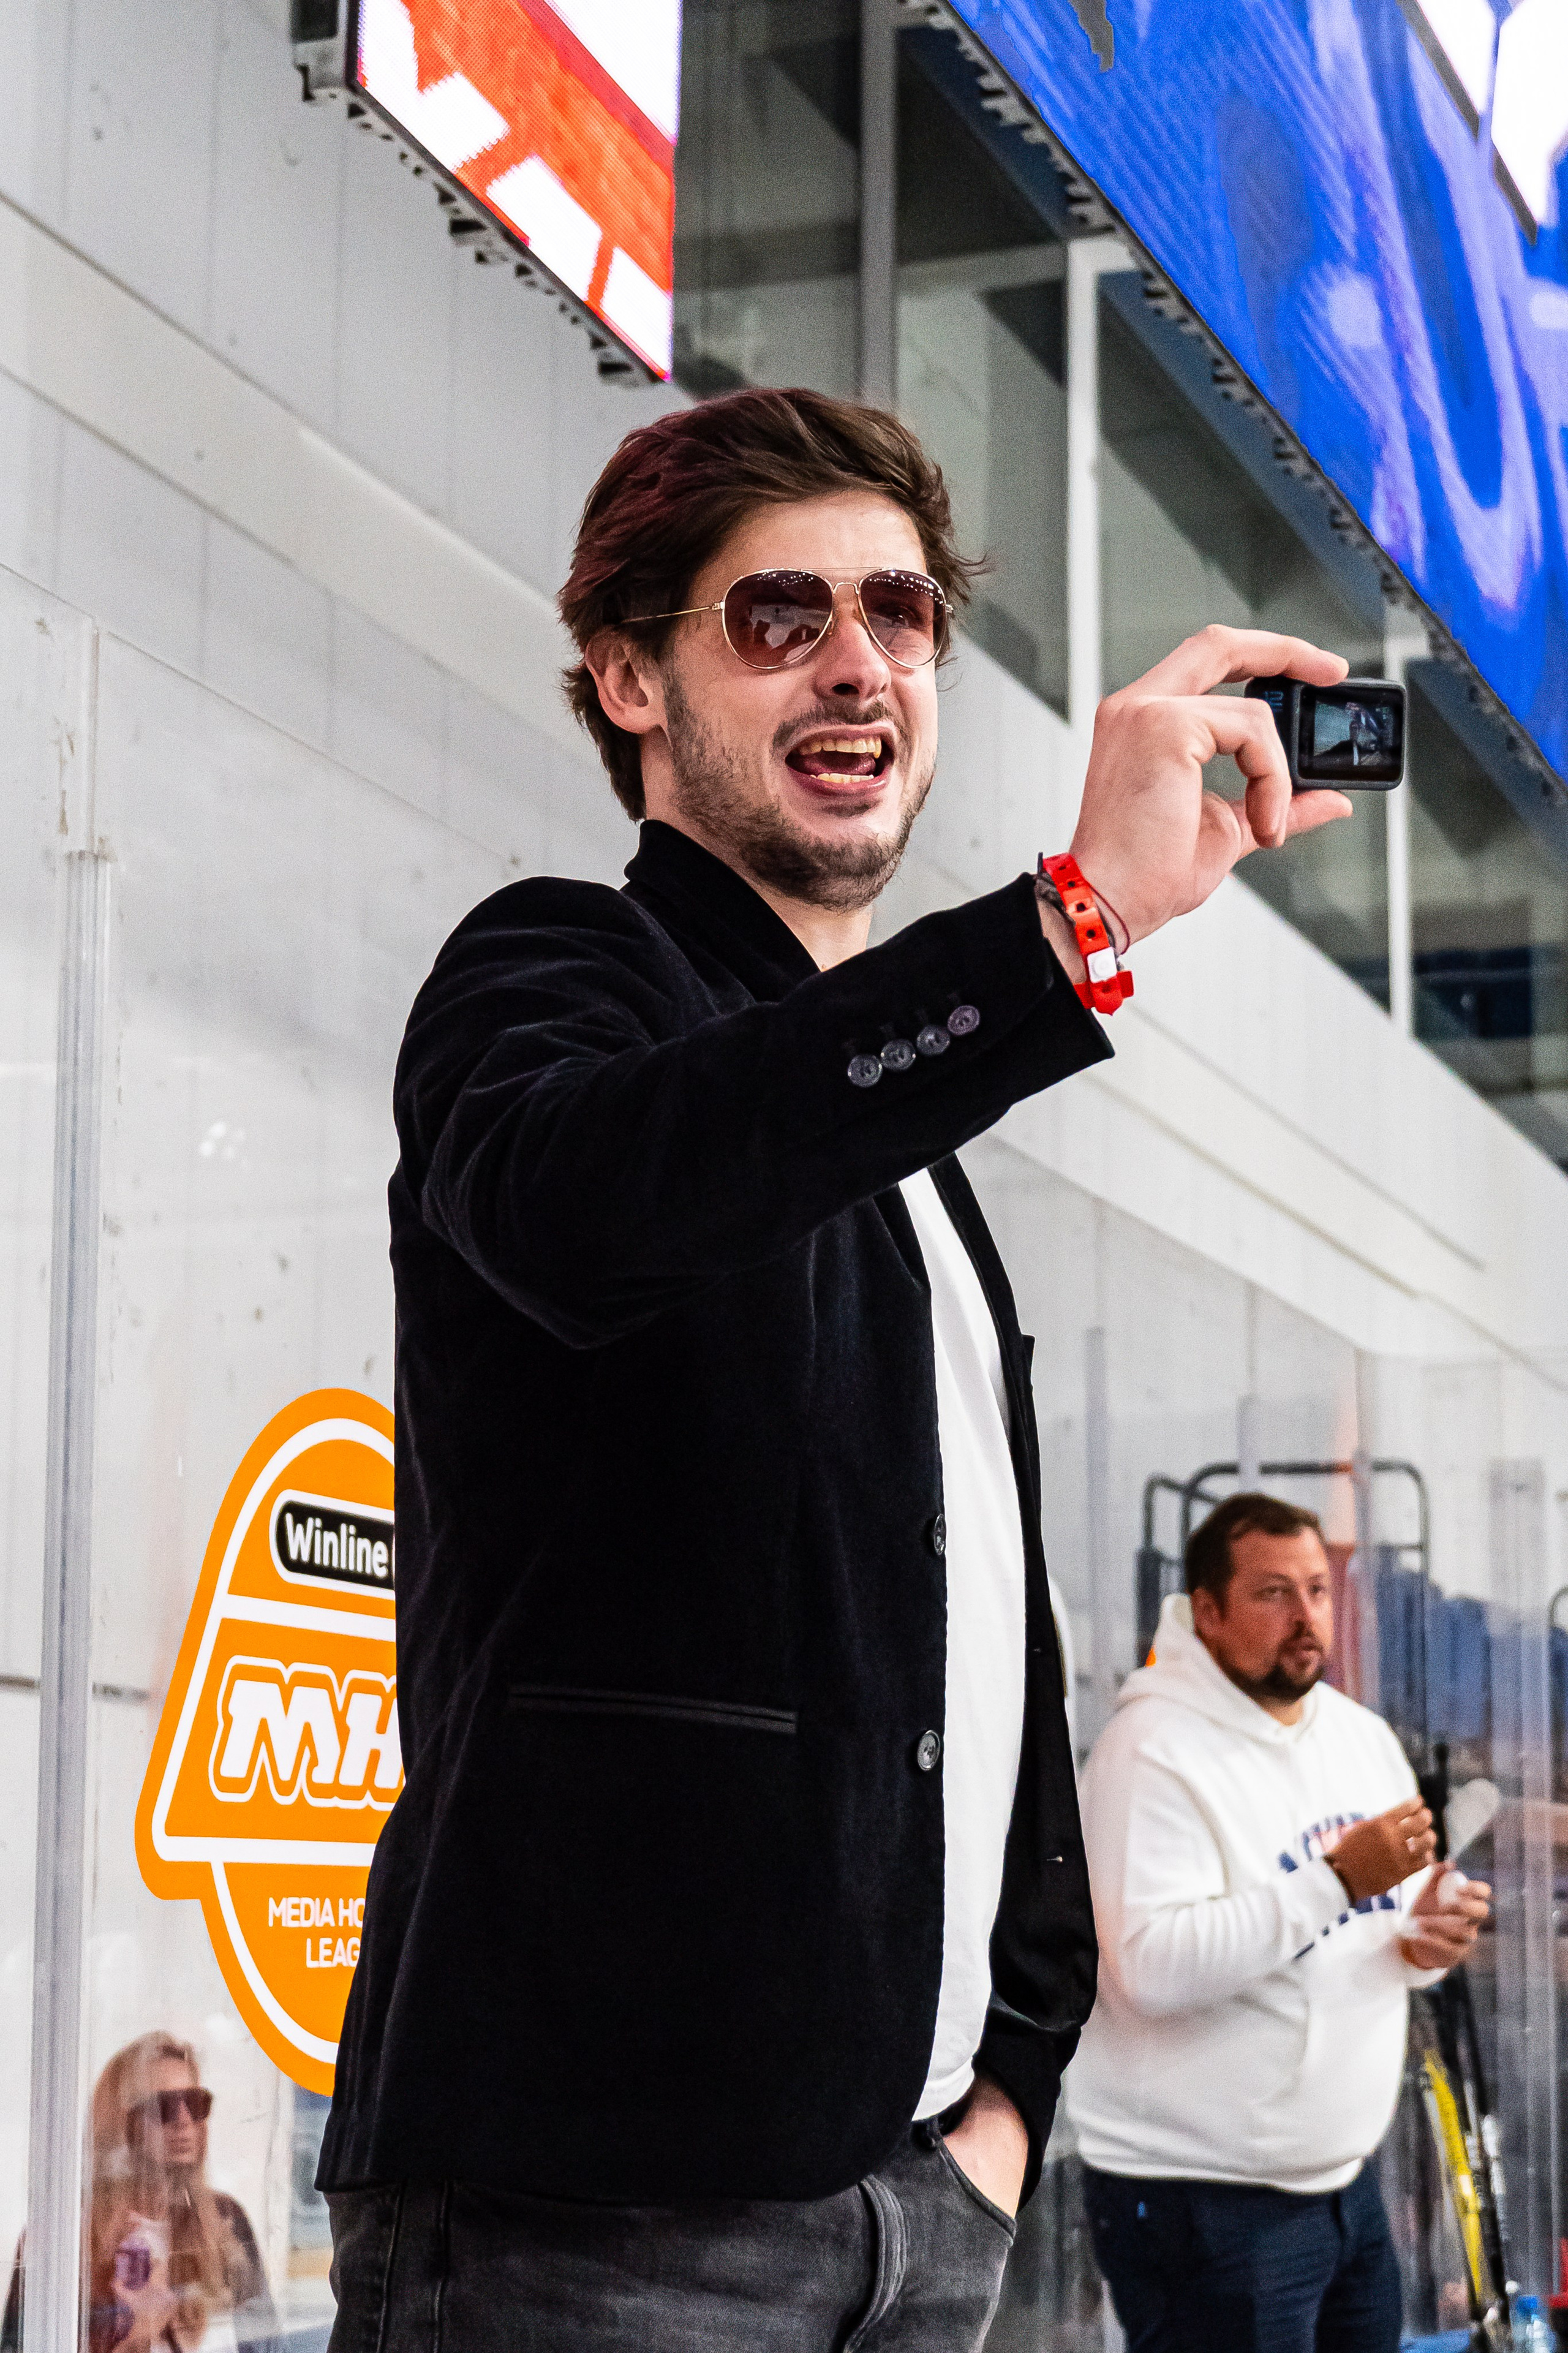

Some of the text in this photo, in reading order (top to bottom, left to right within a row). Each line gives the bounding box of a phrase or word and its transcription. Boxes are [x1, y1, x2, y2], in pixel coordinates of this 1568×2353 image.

[284, 1512, 389, 1579] Winline
[268, 1897, 335, 1928] MEDIA
[305, 1937, 361, 1969] LEAG
